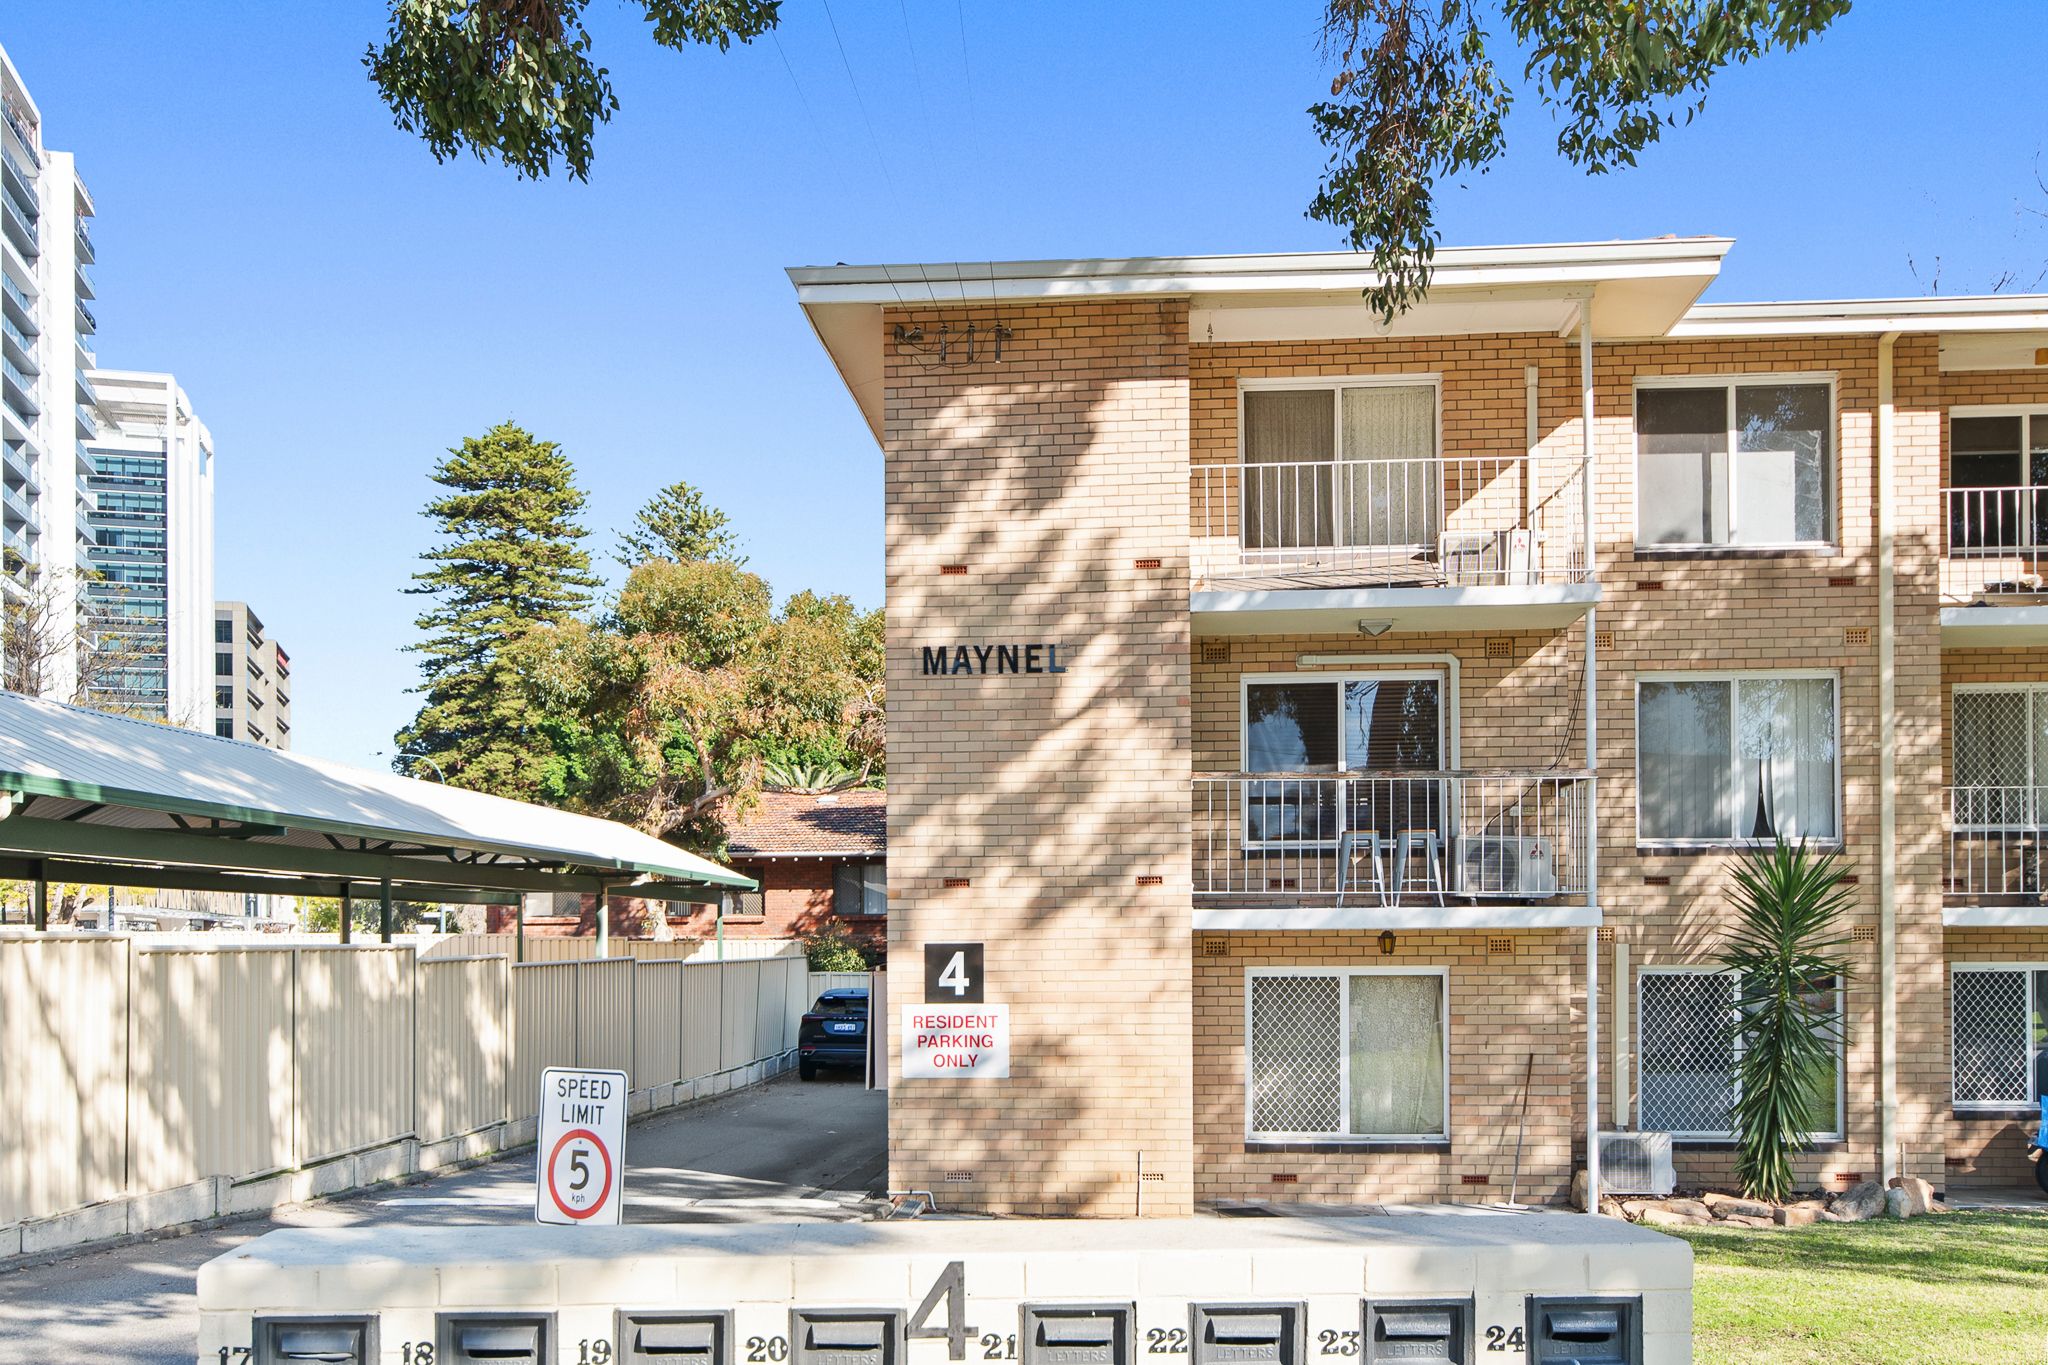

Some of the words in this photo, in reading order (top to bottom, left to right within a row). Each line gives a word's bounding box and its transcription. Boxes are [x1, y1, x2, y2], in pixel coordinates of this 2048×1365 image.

[922, 644, 1066, 675] MAYNEL
[938, 951, 970, 996] 4
[913, 1015, 998, 1029] RESIDENT
[917, 1034, 993, 1048] PARKING
[933, 1054, 978, 1068] ONLY
[557, 1078, 611, 1100] SPEED
[561, 1104, 604, 1125] LIMIT
[569, 1149, 589, 1191] 5
[571, 1193, 585, 1203] kph
[906, 1261, 979, 1361] 4
[746, 1336, 788, 1362] 20
[980, 1333, 1018, 1360] 21
[1146, 1328, 1188, 1354] 22
[1317, 1329, 1360, 1356] 23
[1387, 1344, 1443, 1356] LETTERS
[1486, 1325, 1526, 1352] 24
[401, 1341, 434, 1365] 18
[577, 1339, 612, 1365] 19
[817, 1354, 877, 1365] LETTERS
[1048, 1350, 1107, 1361] LETTERS
[1216, 1347, 1274, 1359] LETTERS
